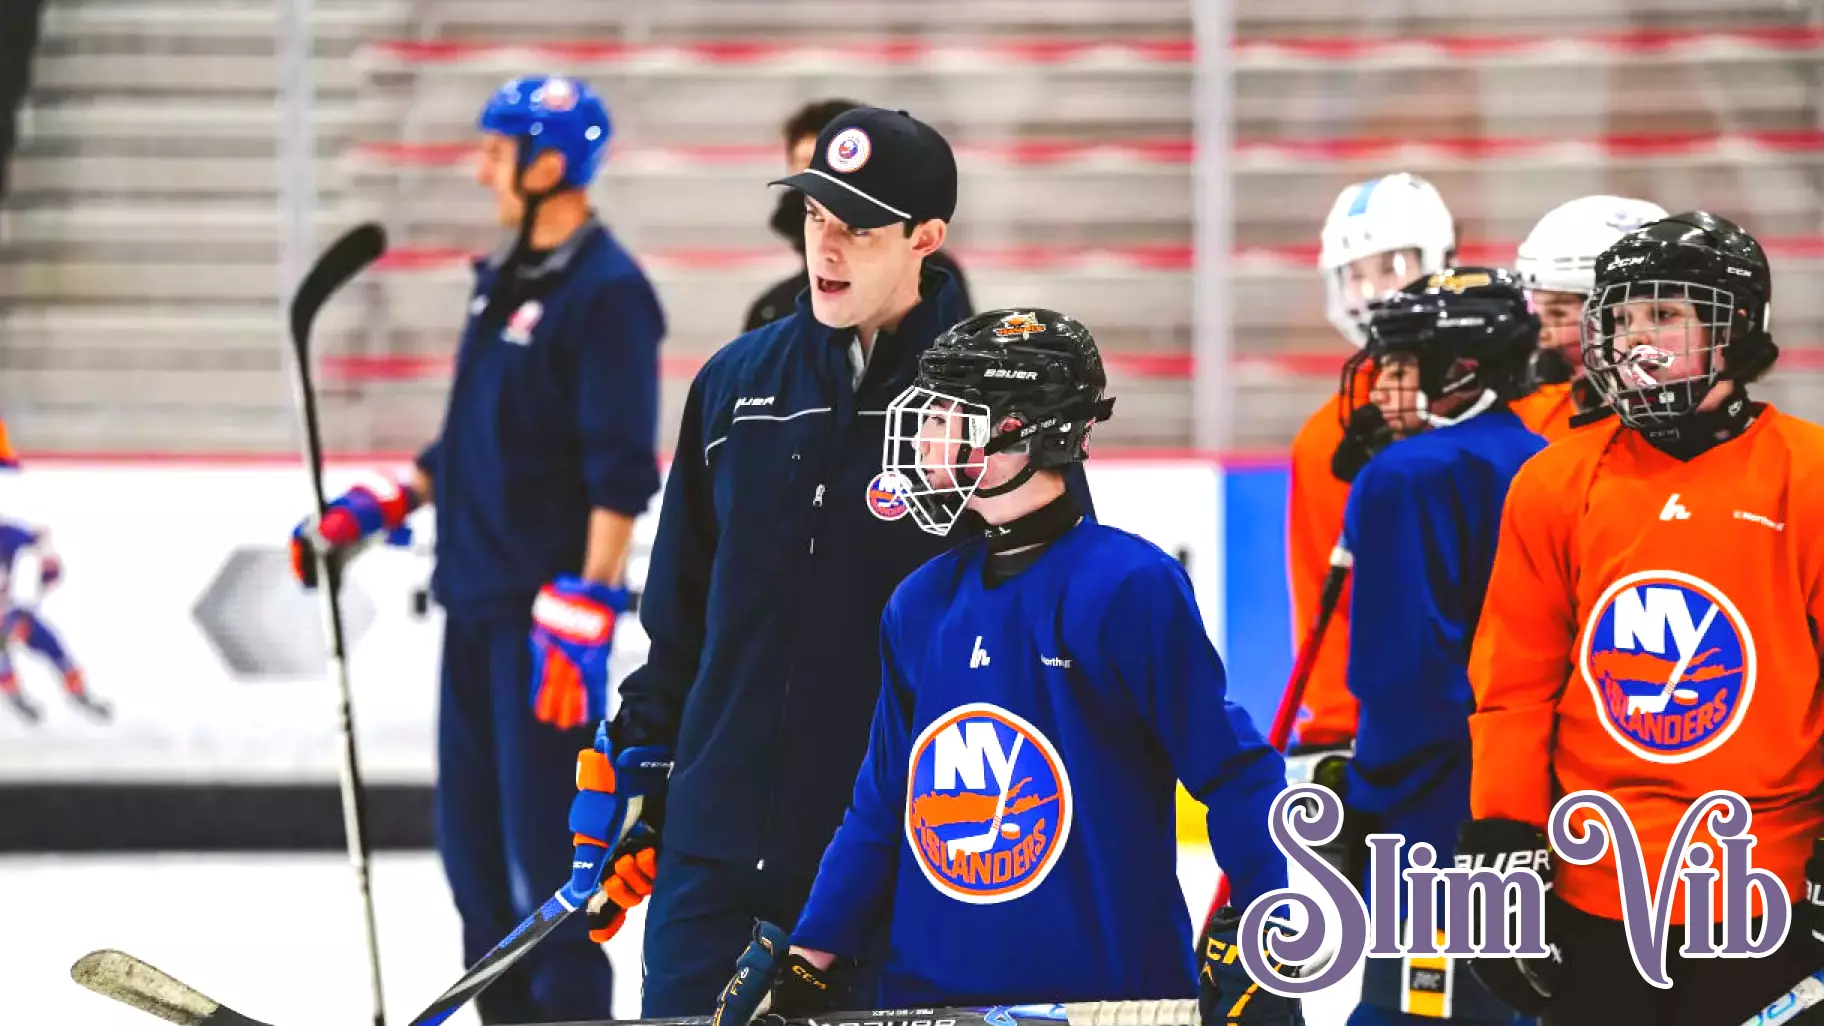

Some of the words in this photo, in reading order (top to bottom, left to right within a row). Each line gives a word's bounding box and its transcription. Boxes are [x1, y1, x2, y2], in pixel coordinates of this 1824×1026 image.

[983, 368, 1039, 381] BAUER
[1613, 585, 1720, 660] NY
[933, 722, 1026, 796] NY
[920, 818, 1047, 885] ISLANDERS
